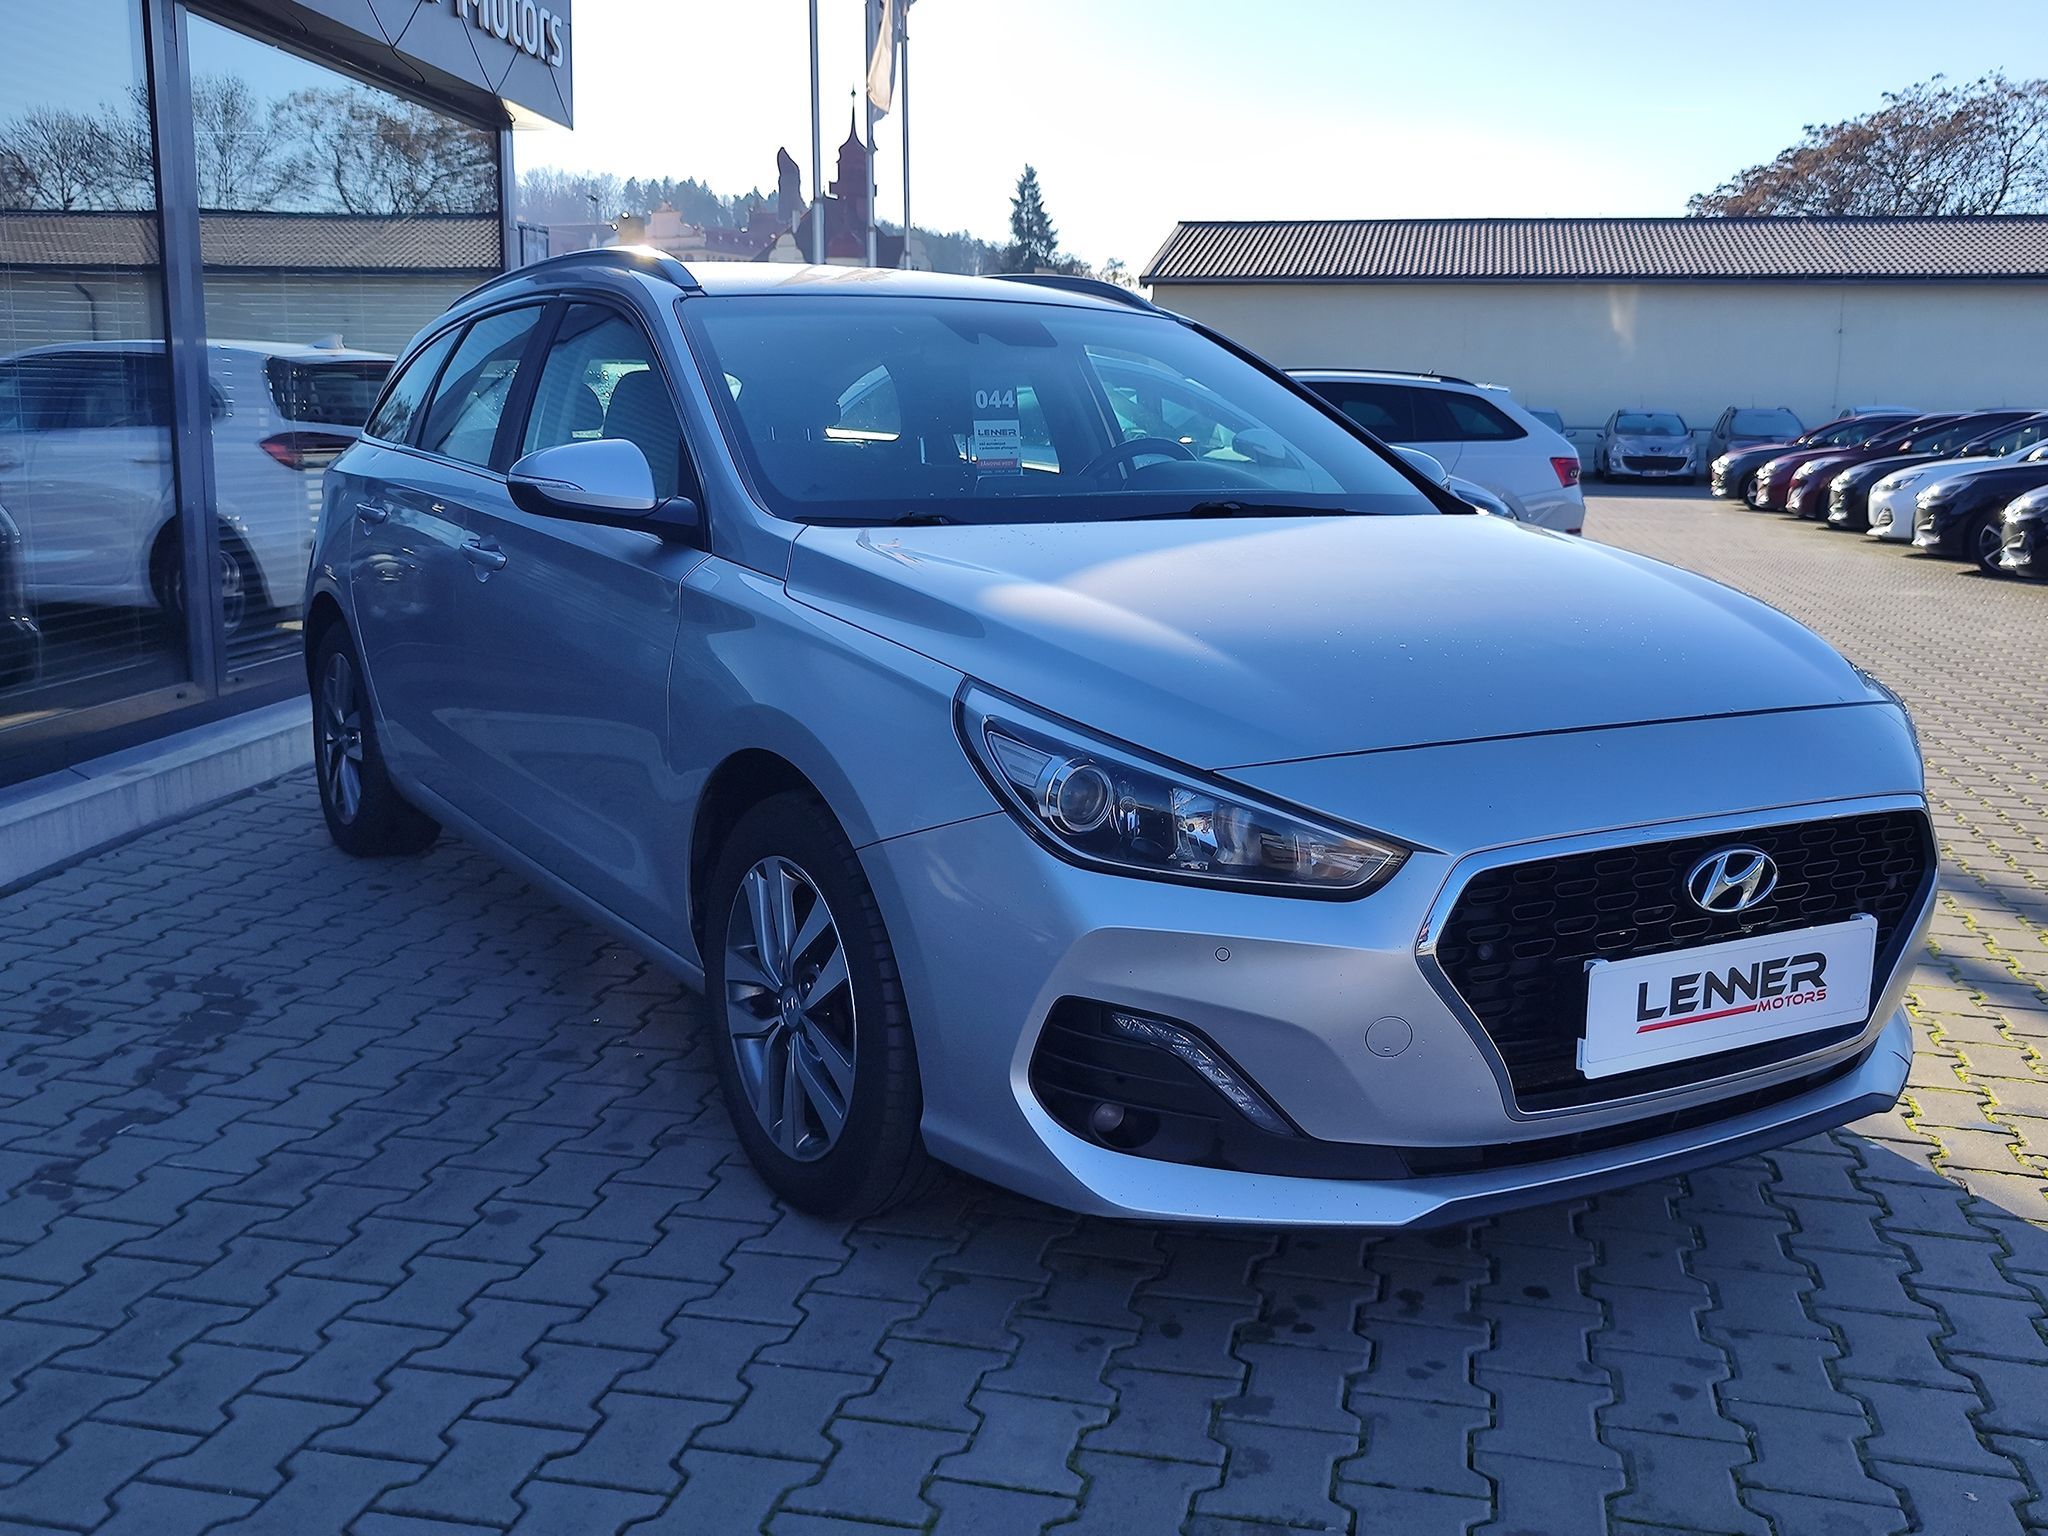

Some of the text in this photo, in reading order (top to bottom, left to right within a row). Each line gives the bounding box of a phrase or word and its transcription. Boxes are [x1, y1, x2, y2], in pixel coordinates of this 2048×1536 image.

[975, 389, 1015, 409] 044
[978, 428, 1017, 437] LENNER
[1637, 952, 1828, 1022] LENNER
[1757, 989, 1828, 1013] MOTORS
